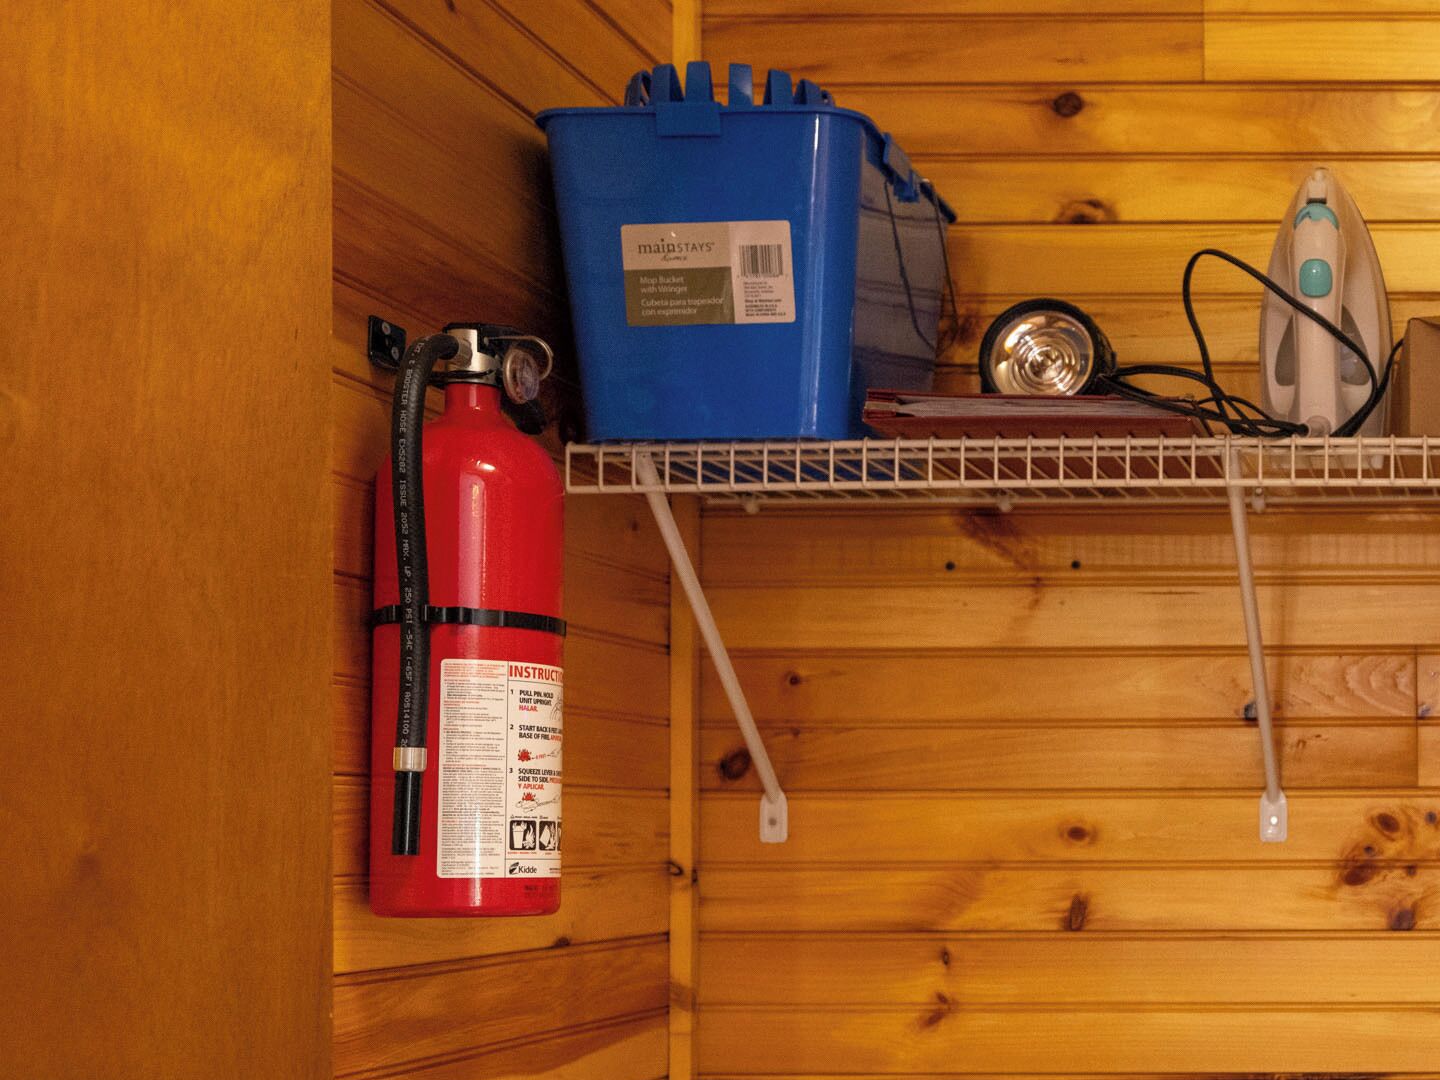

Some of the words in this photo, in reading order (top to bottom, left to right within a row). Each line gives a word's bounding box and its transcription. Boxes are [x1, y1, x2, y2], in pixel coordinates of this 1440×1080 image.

[640, 276, 658, 285] Mop
[659, 275, 684, 284] Bucket
[640, 285, 657, 294] with
[659, 285, 688, 295] Wringer
[641, 298, 668, 307] Cubeta
[401, 368, 413, 405] BOOSTER
[399, 480, 407, 507] ISSUE
[405, 608, 413, 624] PSI
[519, 724, 535, 732] START
[518, 866, 538, 874] Kidde
